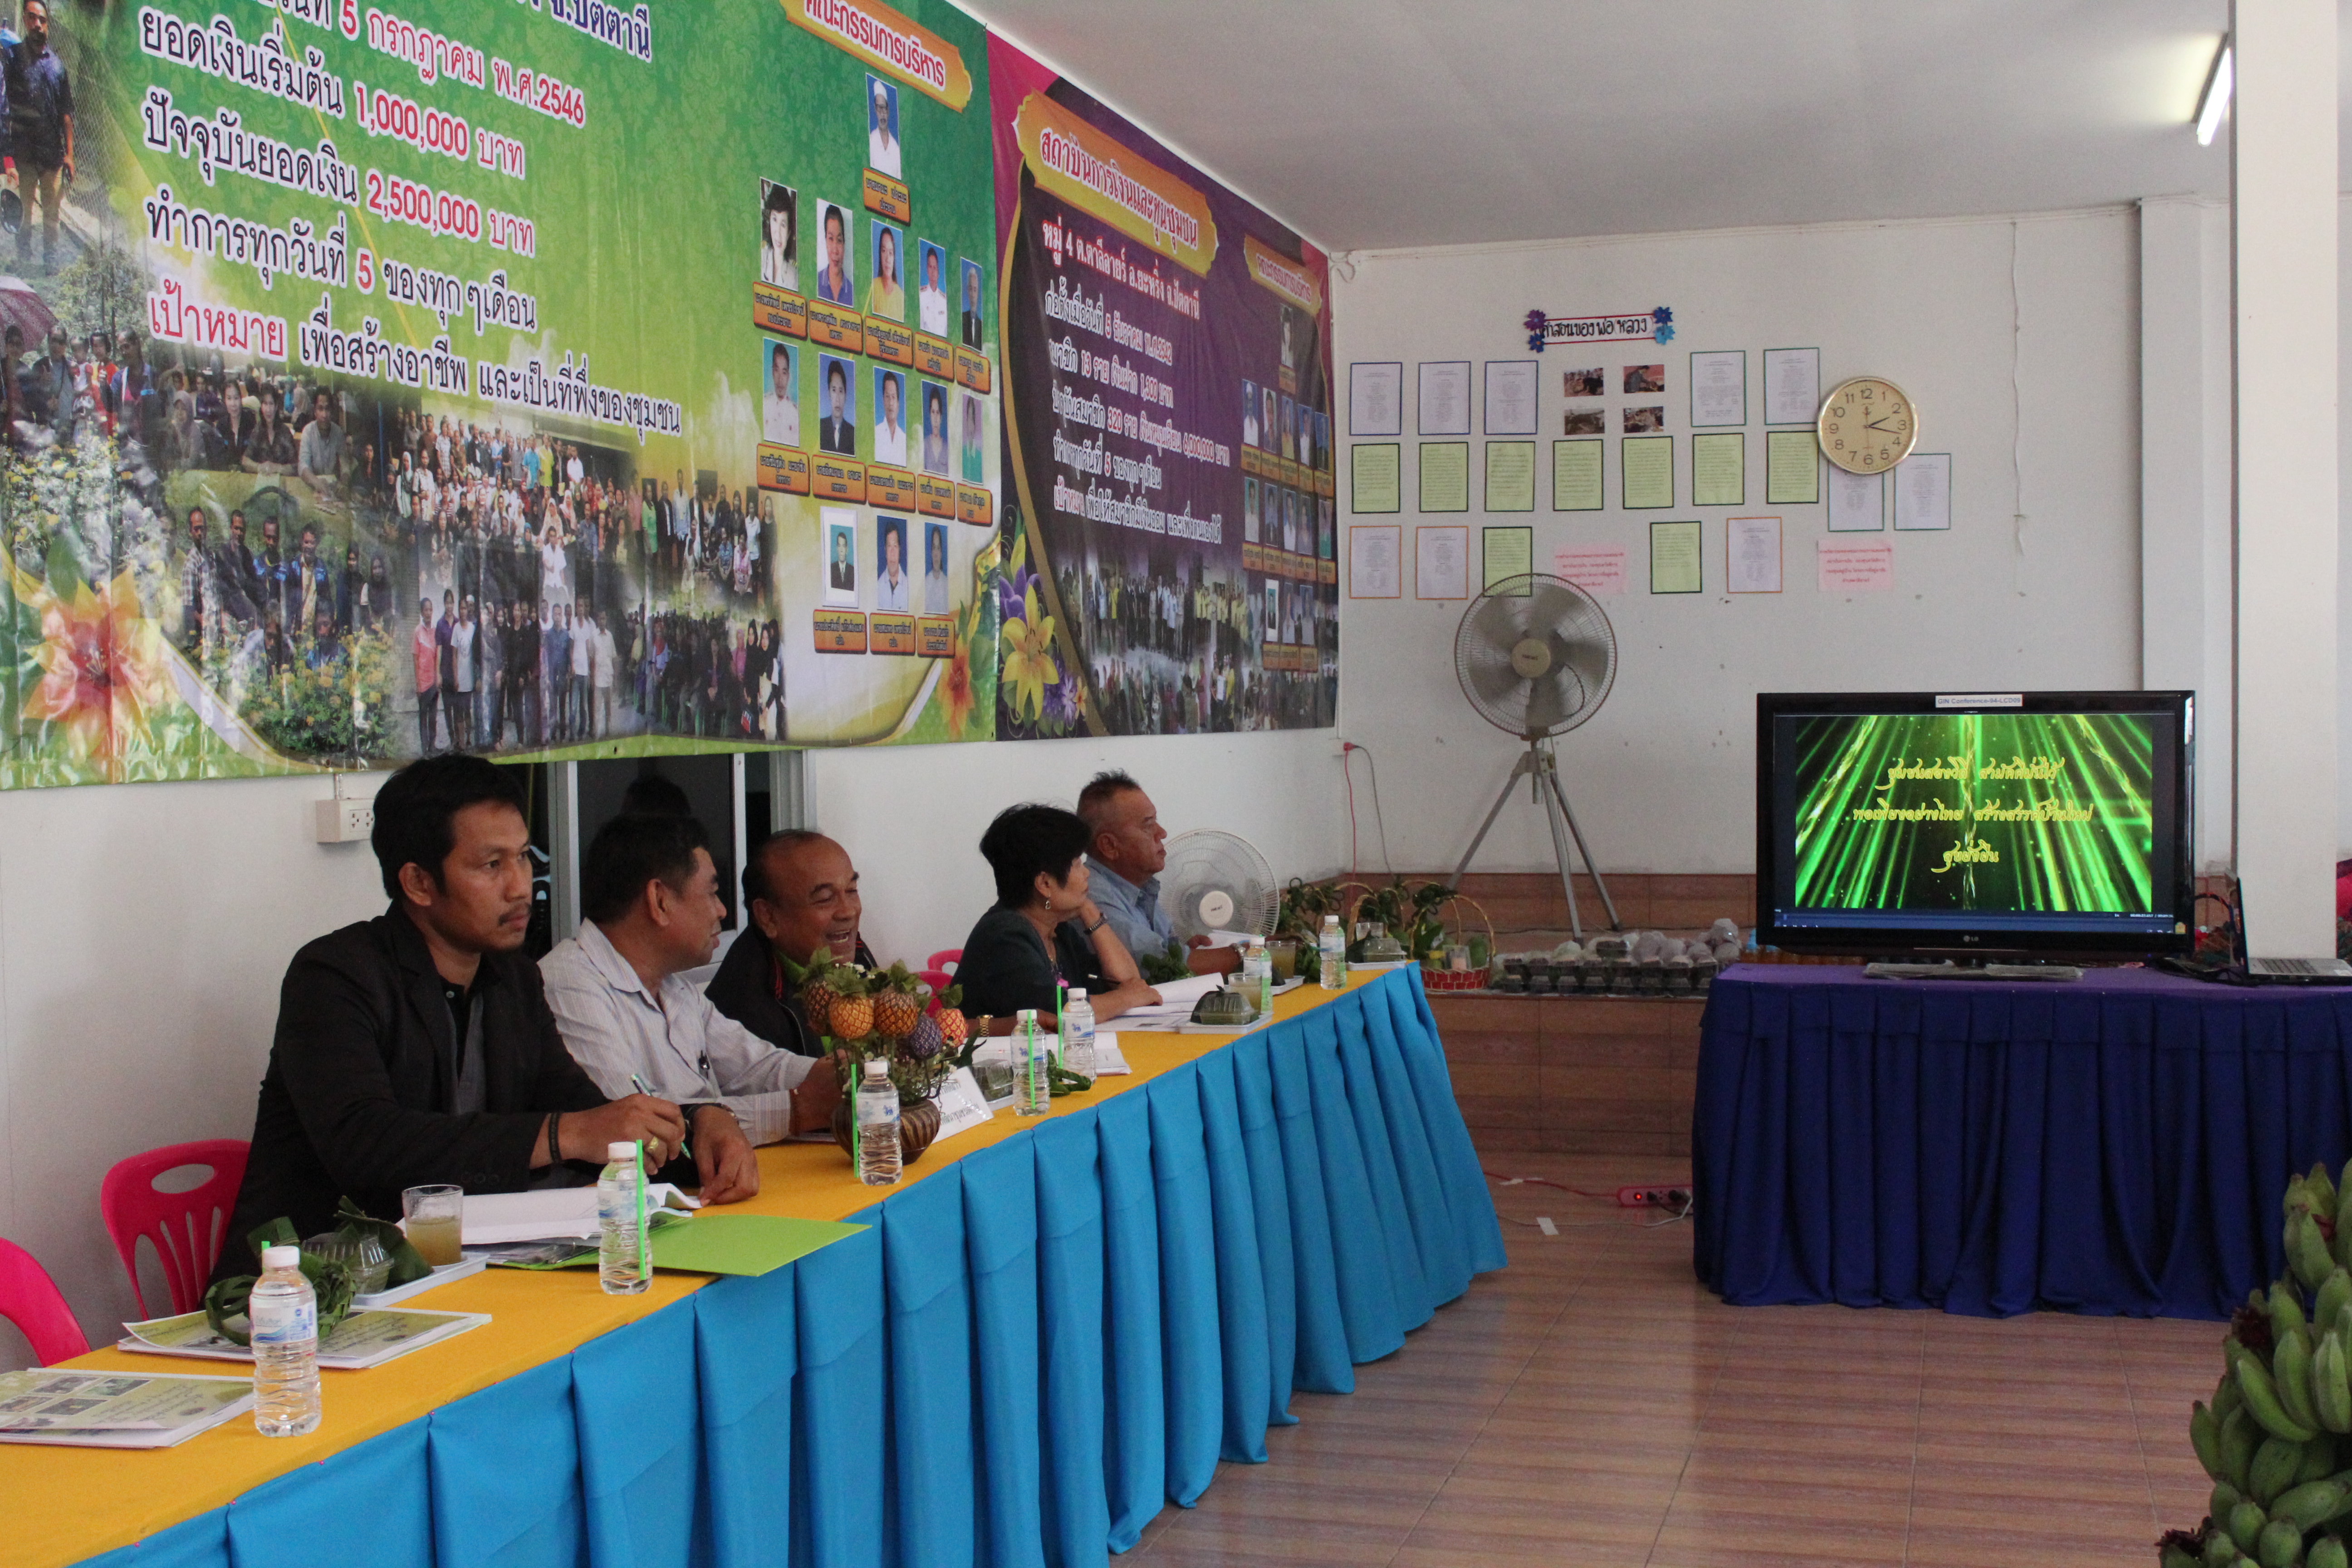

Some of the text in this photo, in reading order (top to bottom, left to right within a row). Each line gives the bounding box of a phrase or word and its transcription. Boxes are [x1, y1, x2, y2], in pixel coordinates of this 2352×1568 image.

[343, 0, 356, 34] 5
[369, 13, 482, 84] กรกฎาคม
[494, 62, 583, 124] พ.ศ.2546
[143, 12, 522, 175] ยอดเงินเริ่มต้น 1,000,000 บาท
[145, 92, 533, 254] ปัจจุบันยอดเงิน 2,500,000 บาท
[1042, 131, 1198, 252] สถาบันการเงินและทุนชุมชน
[147, 189, 345, 285] ทำการทุกวันที่
[358, 253, 372, 289] 5
[1043, 214, 1062, 267] หมู่
[1066, 229, 1073, 257] 4
[1105, 313, 1112, 339] 5
[151, 279, 680, 442] เป้าหมาย เพื่อสร้างอาชีพ และเป็นที่พึ่งของชุมชน
[1049, 336, 1078, 373] มาชิก
[1081, 349, 1092, 378] 13
[1093, 356, 1109, 385] ราย
[1158, 383, 1174, 408] บาท
[1845, 392, 1855, 403] 11
[1861, 388, 1872, 399] 12
[1882, 391, 1886, 401] 1
[1831, 407, 1845, 417] 10
[1892, 403, 1901, 413] 2
[1052, 379, 1105, 429] ปัจุบันสมาชิก
[1107, 406, 1122, 434] 320
[1124, 413, 1137, 440] ราย
[1215, 443, 1230, 467] บาท
[1829, 423, 1839, 434] 9
[1898, 420, 1906, 430] 3
[1835, 439, 1844, 450] 8
[1892, 437, 1901, 447] 4
[1848, 451, 1857, 461] 7
[1863, 455, 1873, 465] 6
[1881, 450, 1889, 460] 5
[1104, 451, 1111, 477] 5
